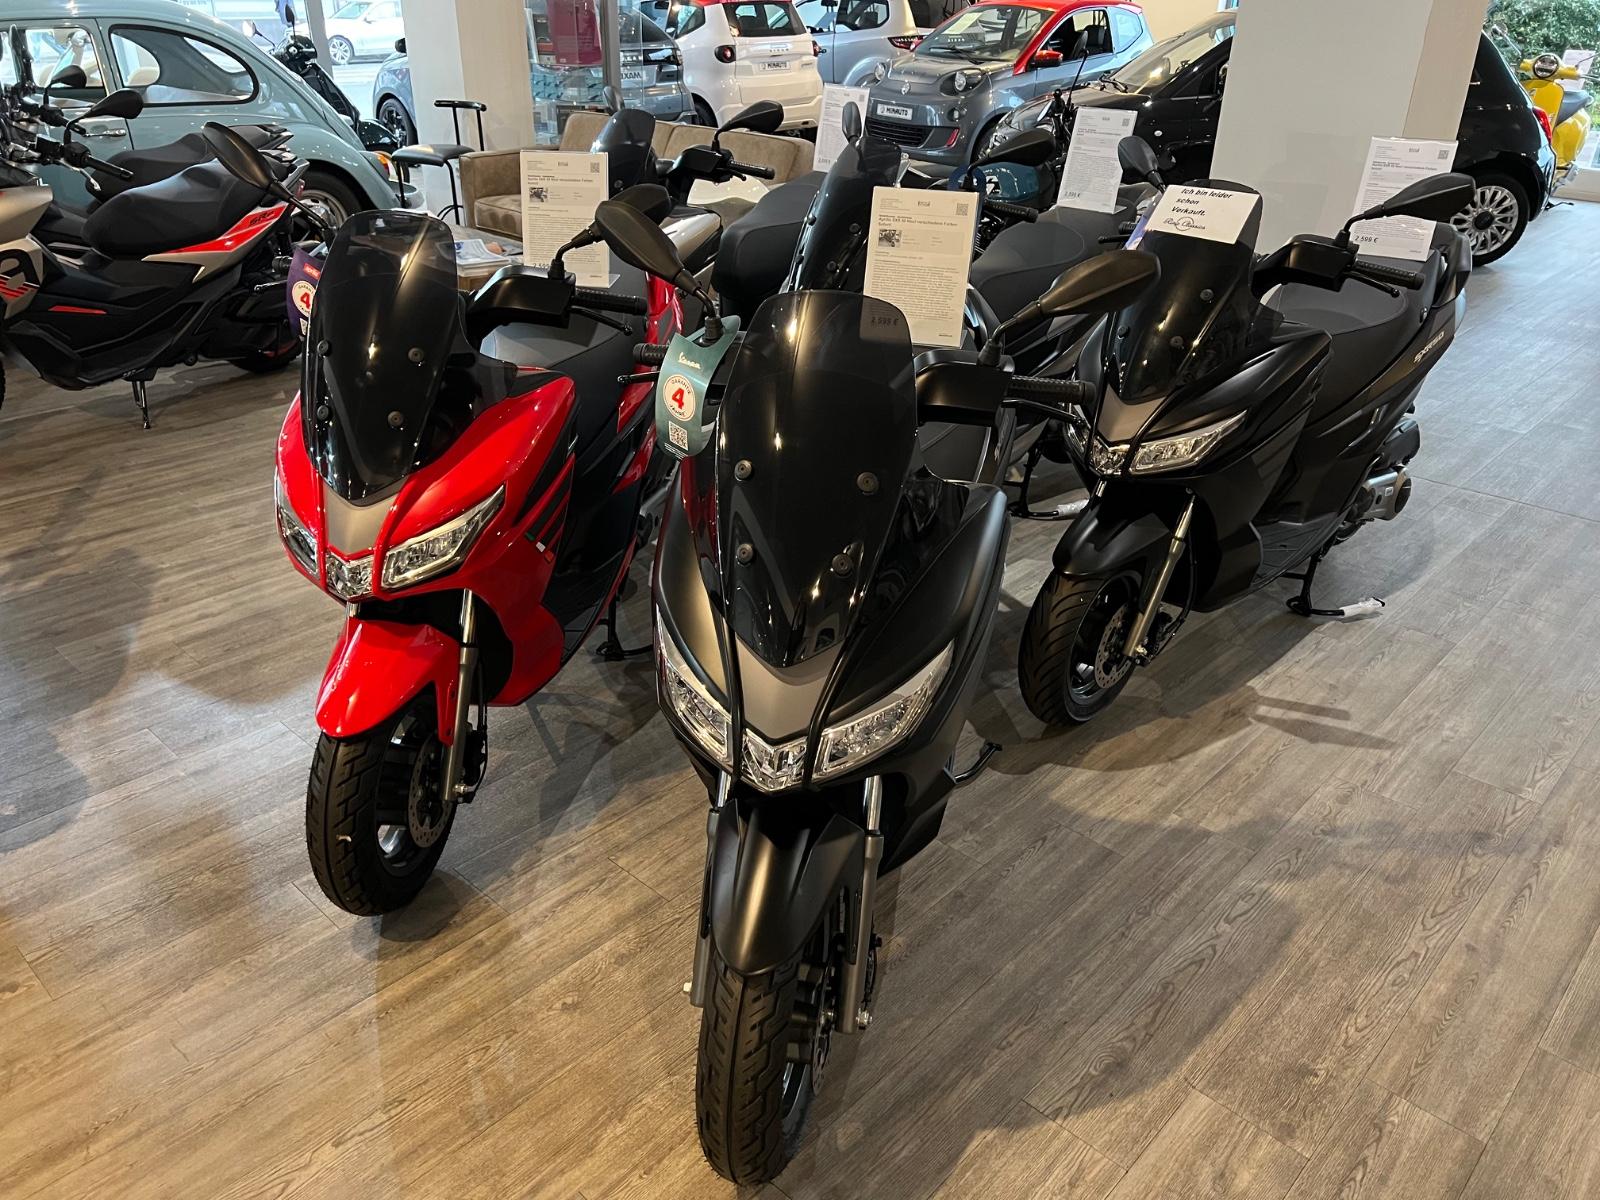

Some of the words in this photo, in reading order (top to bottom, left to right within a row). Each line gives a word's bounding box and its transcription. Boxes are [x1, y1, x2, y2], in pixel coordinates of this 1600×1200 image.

[886, 106, 909, 117] MINAUTO
[1209, 190, 1233, 199] leider
[300, 292, 311, 310] 4
[672, 387, 685, 410] 4
